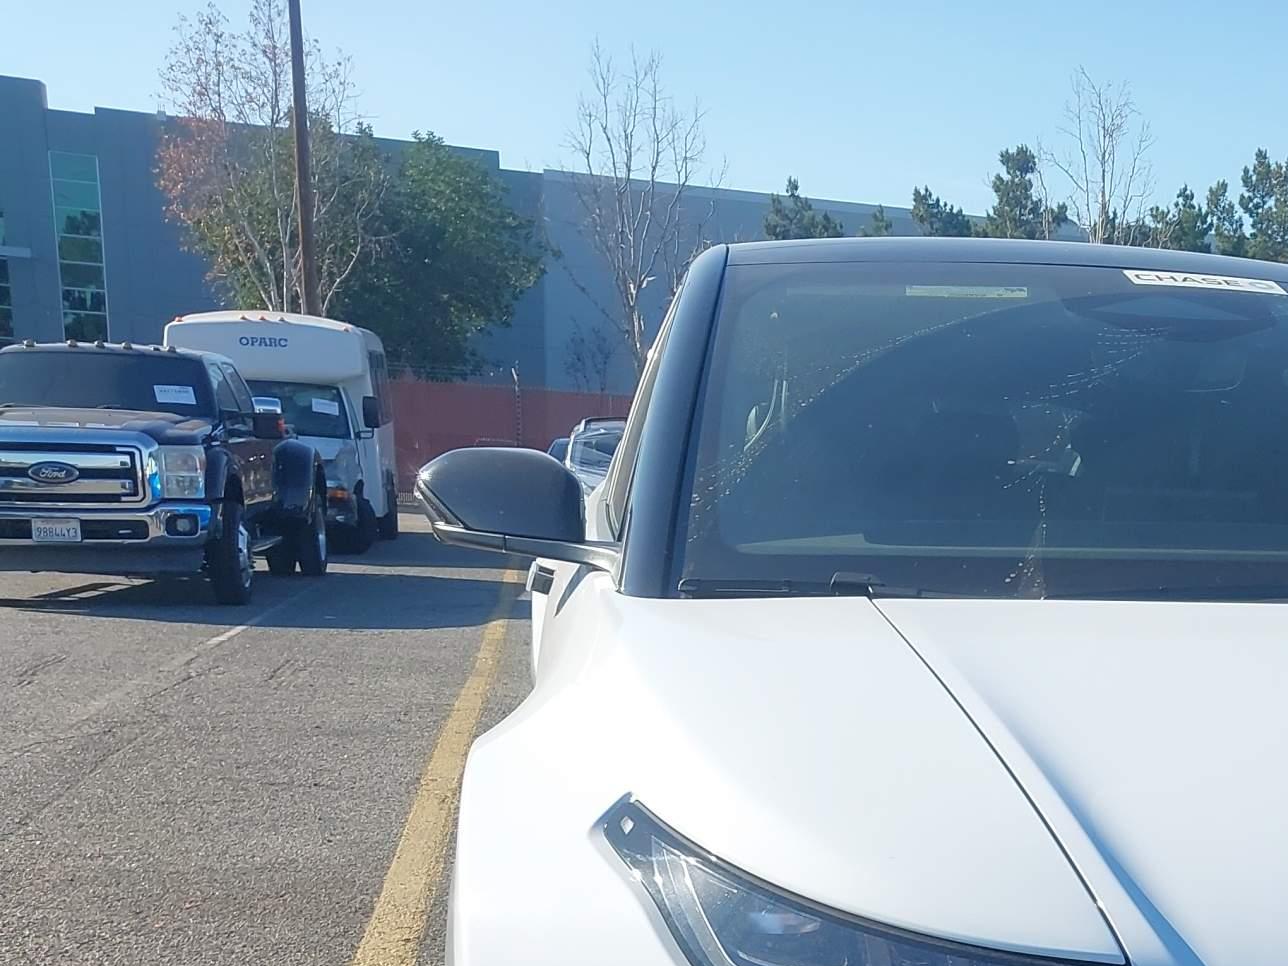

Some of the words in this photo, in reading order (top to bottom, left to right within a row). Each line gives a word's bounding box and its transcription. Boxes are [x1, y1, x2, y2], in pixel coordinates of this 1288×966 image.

[1134, 273, 1241, 287] CHASE
[239, 336, 288, 348] OPARC
[40, 468, 66, 479] Ford
